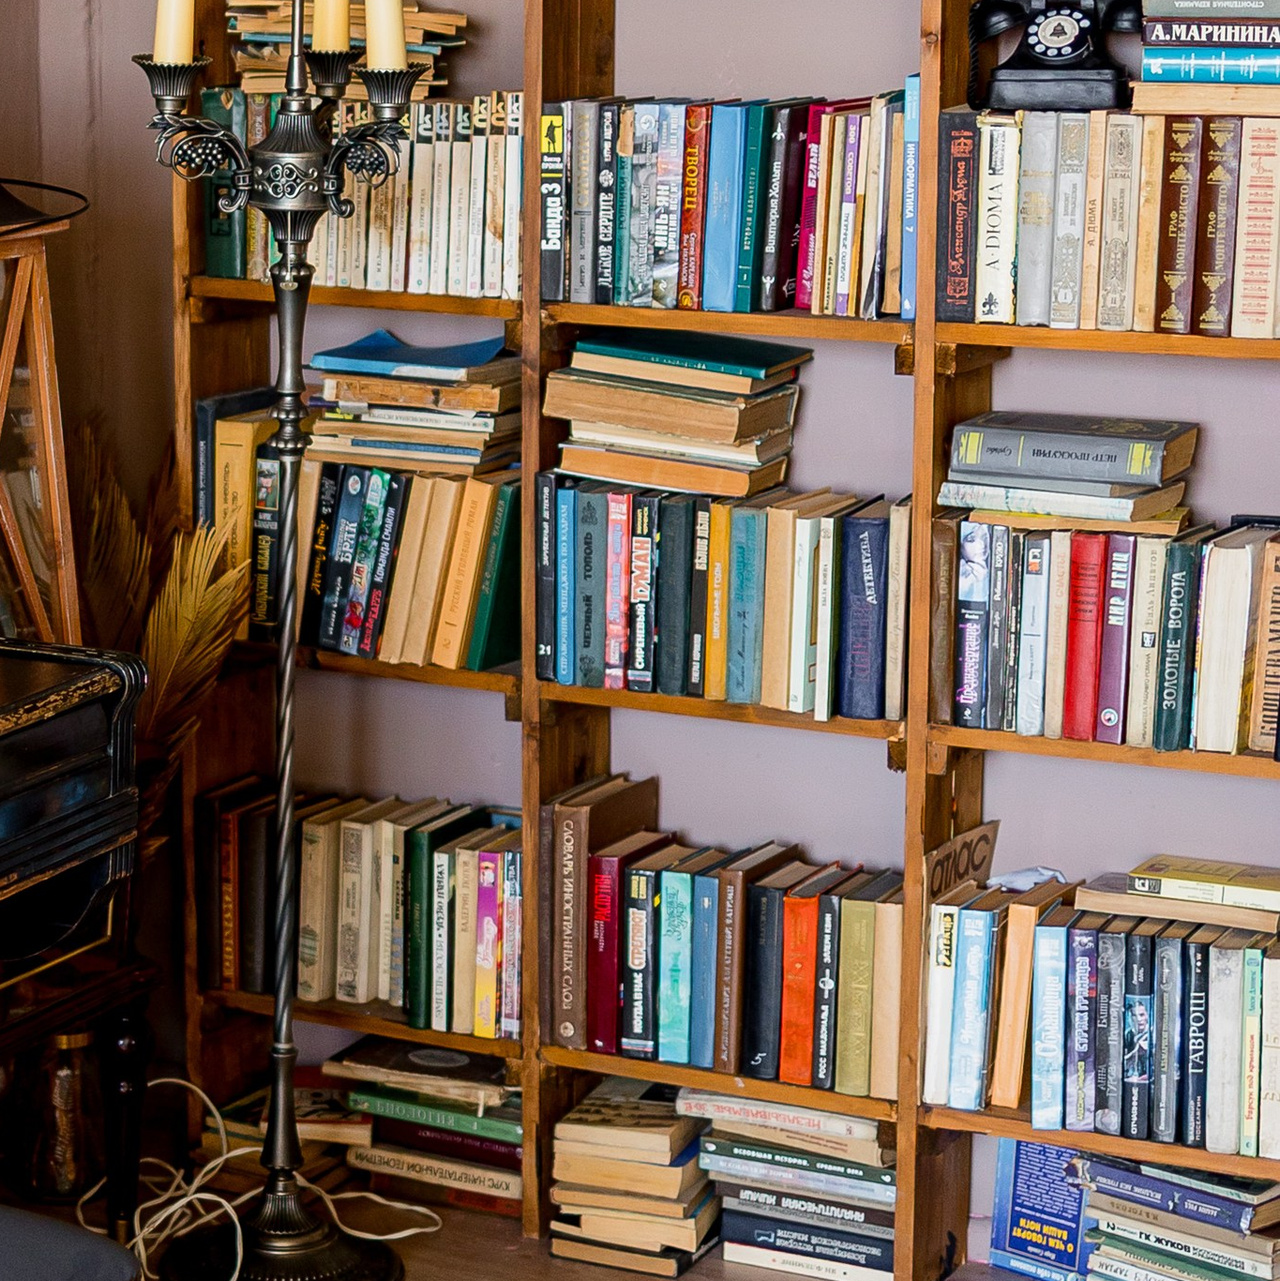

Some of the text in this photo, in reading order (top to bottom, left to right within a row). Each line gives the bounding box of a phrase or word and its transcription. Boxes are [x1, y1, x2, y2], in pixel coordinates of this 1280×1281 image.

[1174, 0, 1265, 8] СТРОИТЕЛЬНАЯ КЕРАМИКА
[685, 145, 699, 210] ТВОРЕЦ
[807, 143, 819, 188] БЕЛЫЙ
[845, 124, 856, 195] 300 СОВЕТОВ
[905, 143, 915, 219] ИНФОРМАТИКА
[540, 182, 562, 251] Банда 3
[599, 191, 614, 241] СЕРДЦЕ
[655, 185, 670, 248] ИНЬ-ЯН
[766, 161, 782, 253] Виктория Холт
[1088, 199, 1097, 234] ДЮМА
[1169, 211, 1178, 238] ГРАФ
[1207, 211, 1216, 238] ГРАФ
[668, 214, 677, 251] ПРОТИВ
[1032, 448, 1117, 462] ПЕТР ПРОСКУРИН
[340, 520, 358, 564] БРАК
[374, 506, 396, 583] Команда СМАЙЛИ
[995, 542, 1003, 568] КРУЗО
[560, 504, 569, 675] СПРАВОЧНИК МЕНЕДЖЕРА ПО КАДРАМ
[583, 532, 593, 648] ЧЕРНЫЙ ТОПОЛЬ
[859, 531, 877, 605] ДЕТЕКТИВА
[1108, 551, 1130, 626] МИР ПТИЦ
[632, 536, 651, 670] СИРЕНЕВЫЙ ТУМАН
[538, 644, 551, 656] 21
[960, 622, 981, 705] Предначертание
[1163, 570, 1187, 711] ЗОЛОТЫЕ ВОРОТА
[562, 820, 574, 1010] СЛОВАРЬ ИНОСТРАННЫХ СЛОВ
[629, 909, 647, 968] СТРЕЛЯЮТ
[824, 913, 832, 964] ЭЛЛЕРИ КВИН
[1075, 956, 1092, 1053] СТРАЖ ГРАНИЦЫ
[818, 1005, 830, 1079] РОСС МАКДОНАЛЬД
[1189, 991, 1206, 1074] ГАВРОШ
[713, 1103, 821, 1130] НЕЗАБЫВАЕМЫЕ
[1130, 1085, 1139, 1136] ОТЧАЯННЫЕ
[355, 1151, 511, 1192] КУРС НАЧЕРТАТЕЛЬНОЙ ГЕОМЕТРИИ
[846, 1166, 864, 1176] ВЕКА
[1133, 1186, 1162, 1200] ВСАДНИК
[739, 1188, 865, 1222] АНАЛИТИЧЕСКАЯ ХИМИЯ
[1019, 1218, 1068, 1240] ВАШИ НОГИ
[775, 1238, 866, 1263] Всемирная история
[776, 1229, 882, 1256] экономической мысли
[1012, 1228, 1074, 1253] О ЧЕМ ГОВОРЯТ
[1153, 1235, 1191, 1253] ЖУКОВ
